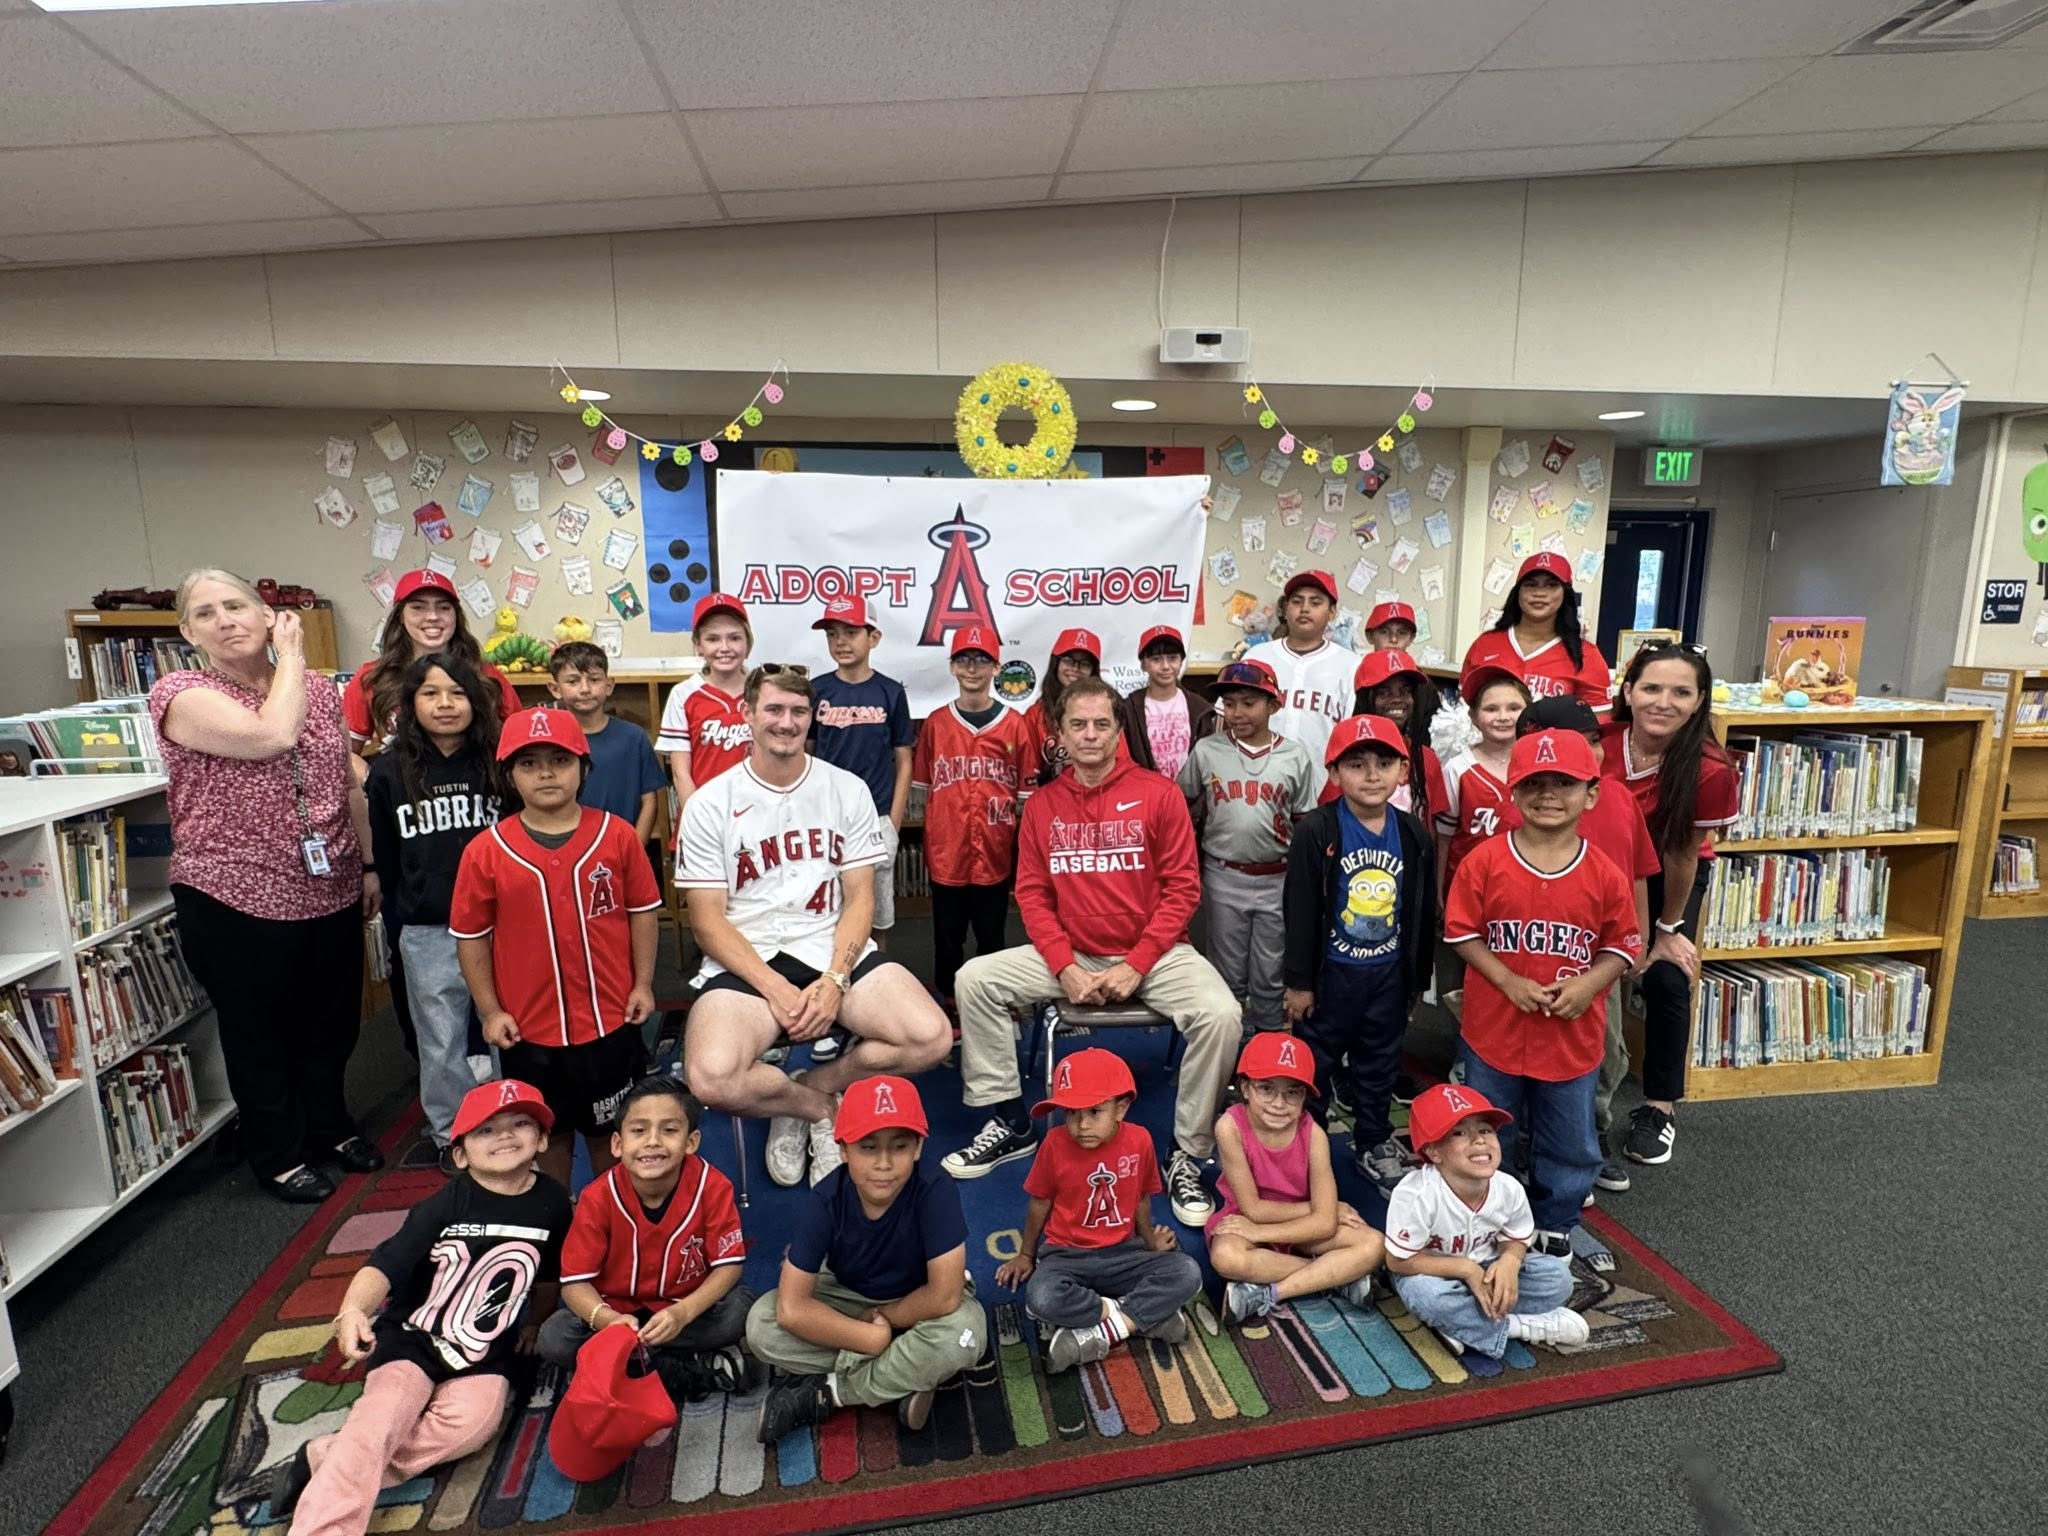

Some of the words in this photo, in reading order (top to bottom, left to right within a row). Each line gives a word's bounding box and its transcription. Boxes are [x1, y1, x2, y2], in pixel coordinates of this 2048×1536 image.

[1655, 451, 1693, 481] EXIT
[421, 569, 439, 585] A
[739, 564, 915, 607] ADOPT
[918, 503, 1004, 647] A
[1004, 565, 1189, 607] SCHOOL
[1986, 583, 2025, 598] STOR
[967, 626, 982, 644] A
[1075, 631, 1088, 648] A
[1787, 629, 1849, 639] BUNNIES
[1388, 650, 1402, 671] A
[529, 711, 552, 737] A
[702, 720, 754, 750] Ange
[1355, 717, 1377, 740] A
[1535, 735, 1557, 764] A
[932, 754, 1018, 792] ANGELS
[432, 782, 470, 795] TUSTIN
[396, 794, 502, 840] COBRAS
[987, 796, 1014, 825] 14
[1050, 816, 1144, 850] ANGELS
[1050, 853, 1145, 875] BASEBALL
[587, 862, 620, 919] A
[1487, 919, 1598, 964] ANGELS
[1278, 1040, 1297, 1068] A
[1057, 1061, 1073, 1090] A
[499, 1081, 521, 1106] A
[875, 1082, 897, 1114] A
[1442, 1087, 1472, 1112] A
[1117, 1155, 1141, 1179] 27
[1082, 1162, 1123, 1228] A
[677, 1235, 706, 1284] A
[407, 1239, 542, 1362] 10
